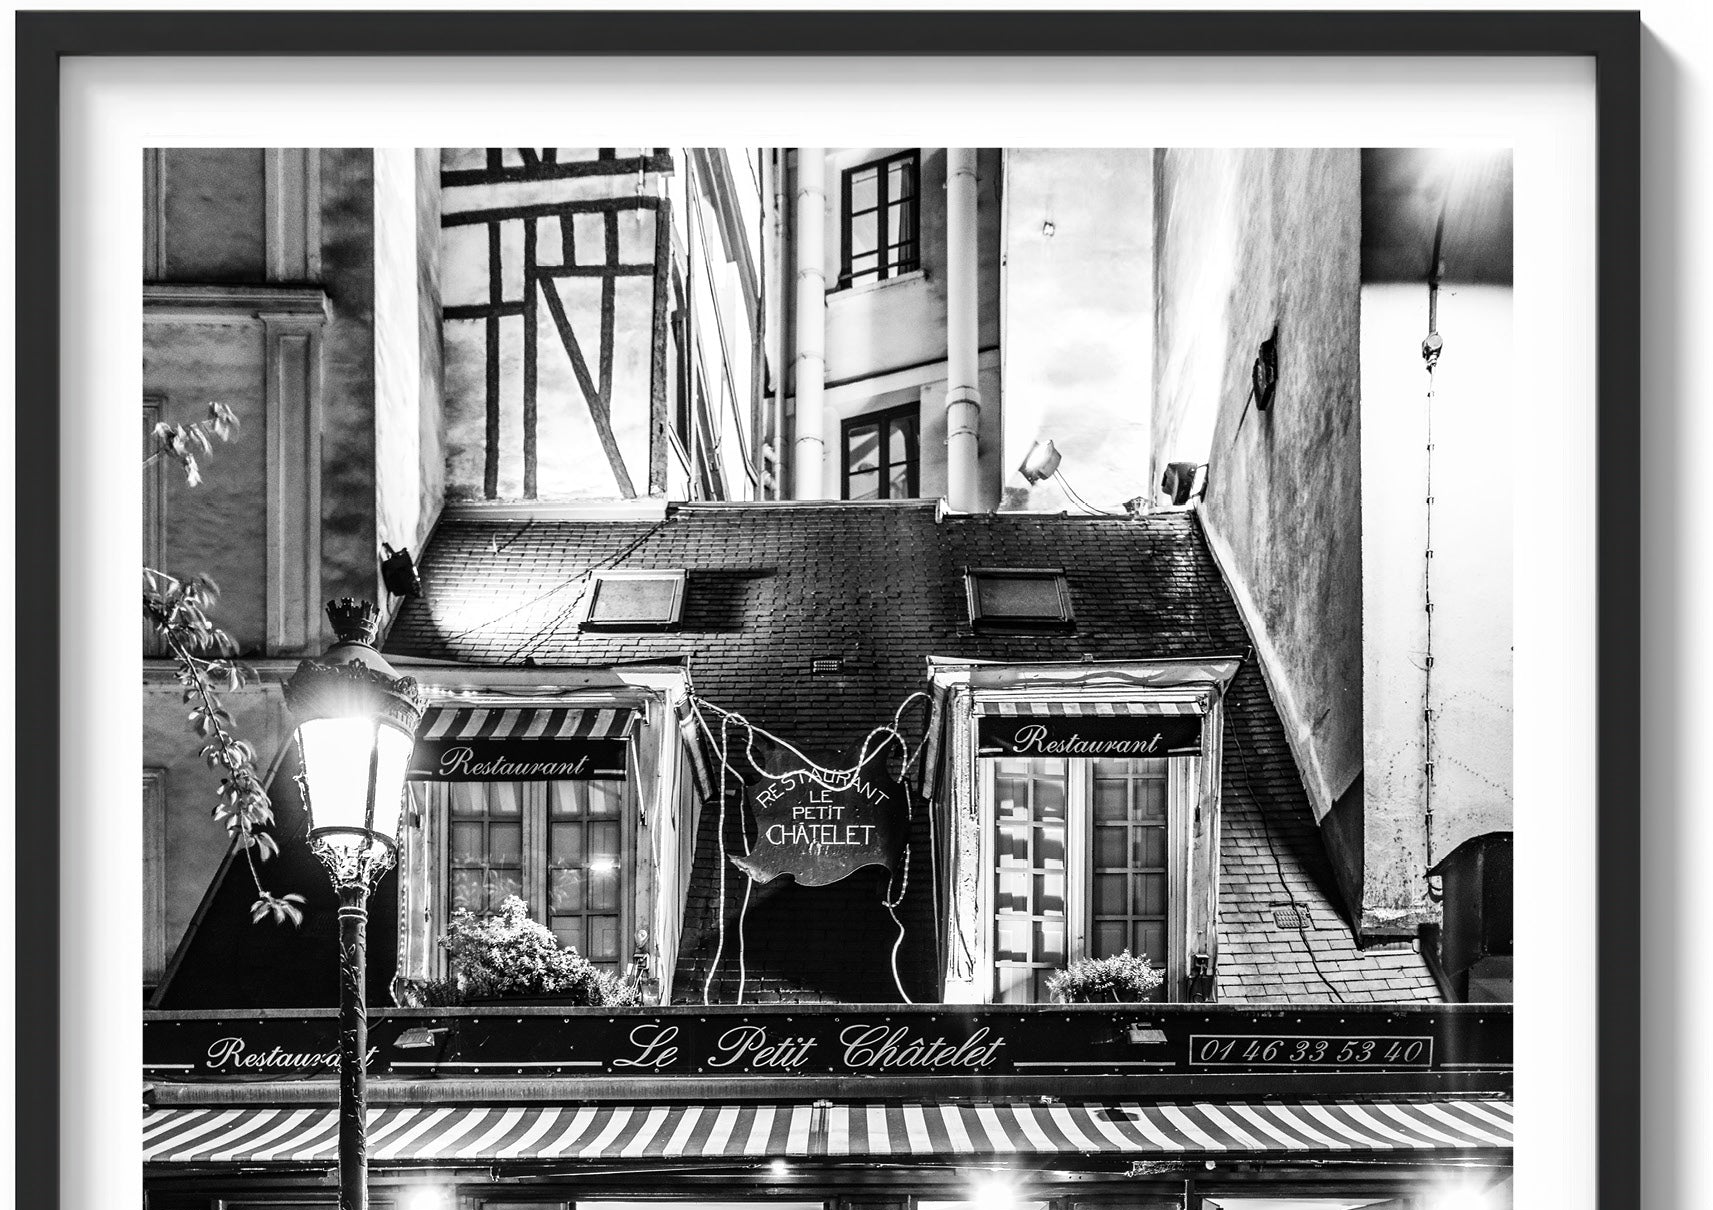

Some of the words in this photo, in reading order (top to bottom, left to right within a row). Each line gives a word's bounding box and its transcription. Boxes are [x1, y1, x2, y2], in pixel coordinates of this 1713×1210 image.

[1012, 724, 1163, 753] Restaurant
[438, 746, 590, 776] Restaurant
[756, 767, 890, 809] RESTAURANT
[810, 790, 834, 804] LE
[206, 1037, 380, 1068] Restaurat
[612, 1024, 679, 1068] Le
[707, 1025, 818, 1068] Petit
[839, 1024, 1006, 1068] Châtelet
[1200, 1039, 1236, 1061] 01
[1242, 1040, 1285, 1061] 46
[1289, 1040, 1329, 1062] 33
[1336, 1040, 1376, 1062] 53
[1384, 1041, 1424, 1062] 40
